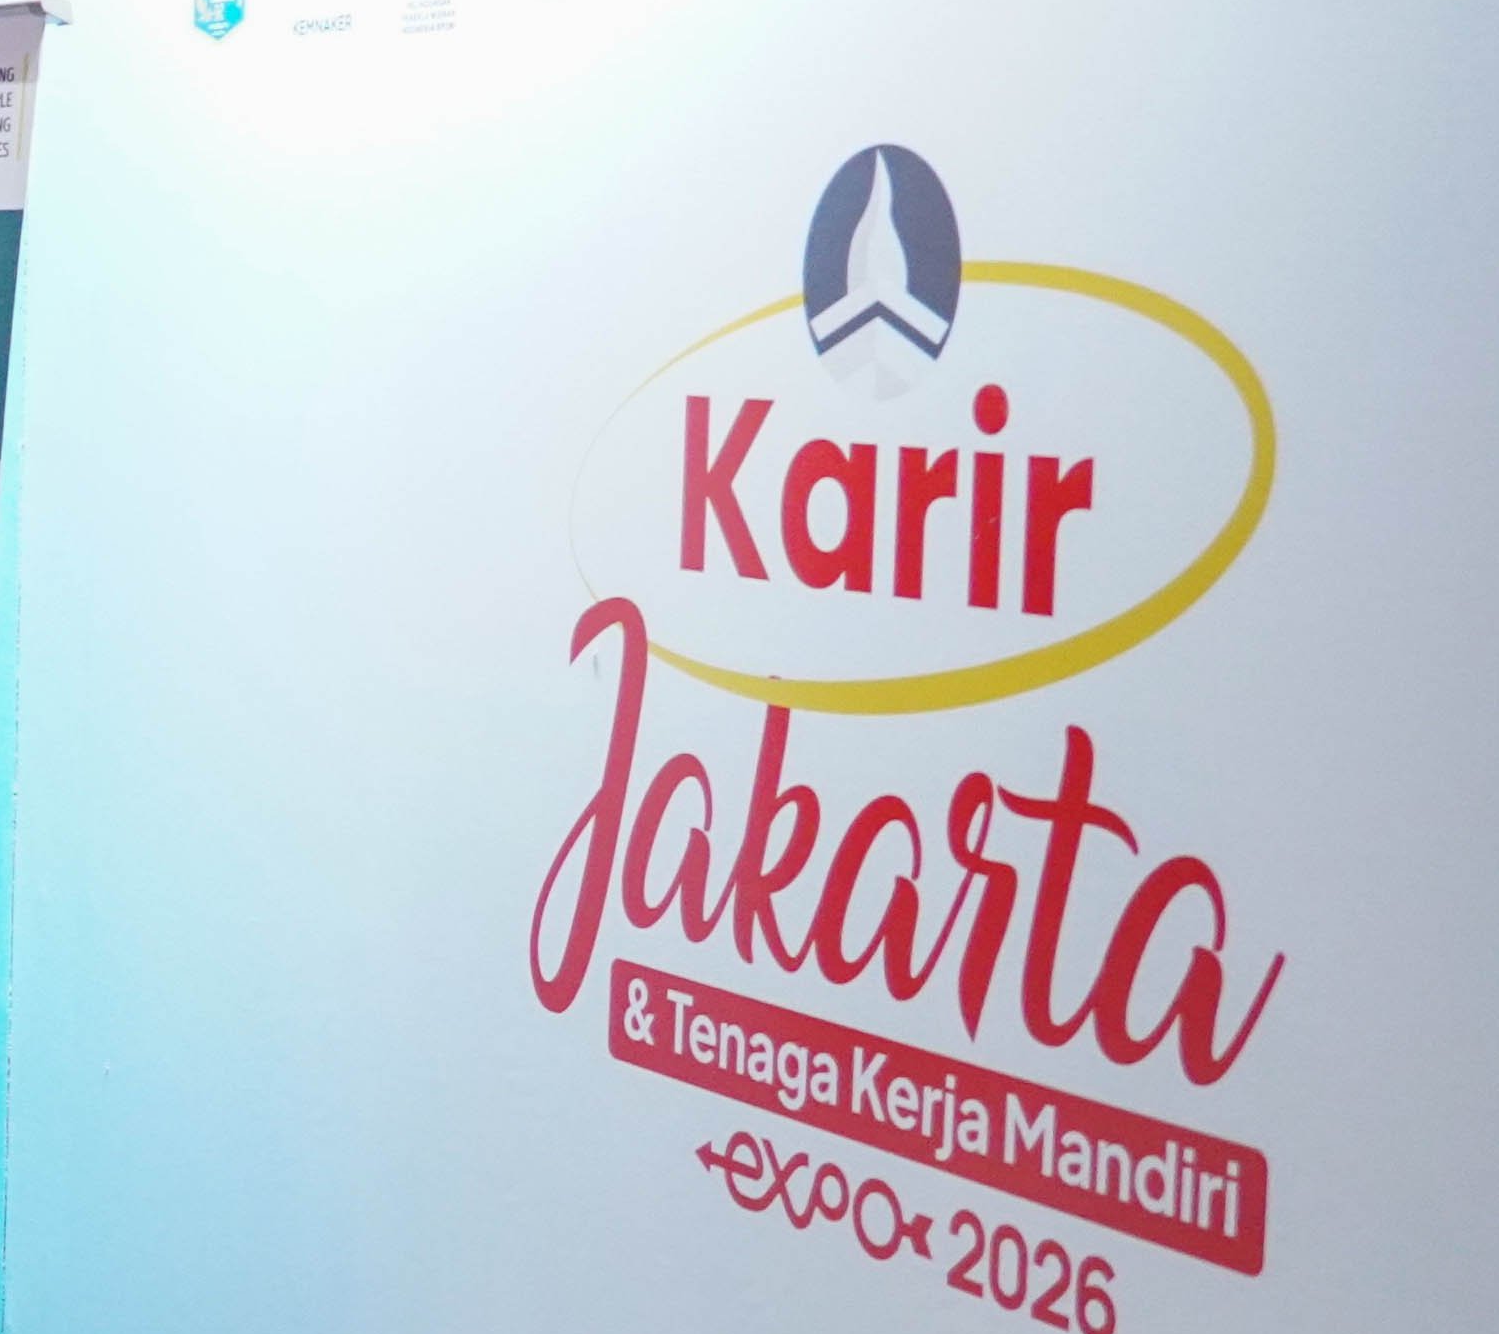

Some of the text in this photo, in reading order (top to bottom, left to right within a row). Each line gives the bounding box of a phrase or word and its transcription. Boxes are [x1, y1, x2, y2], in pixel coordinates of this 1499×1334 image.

[678, 383, 1095, 618] Karir
[529, 594, 1286, 1087] Jakarta
[622, 976, 1241, 1239] & Tenaga Kerja Mandiri
[707, 1129, 908, 1262] expo
